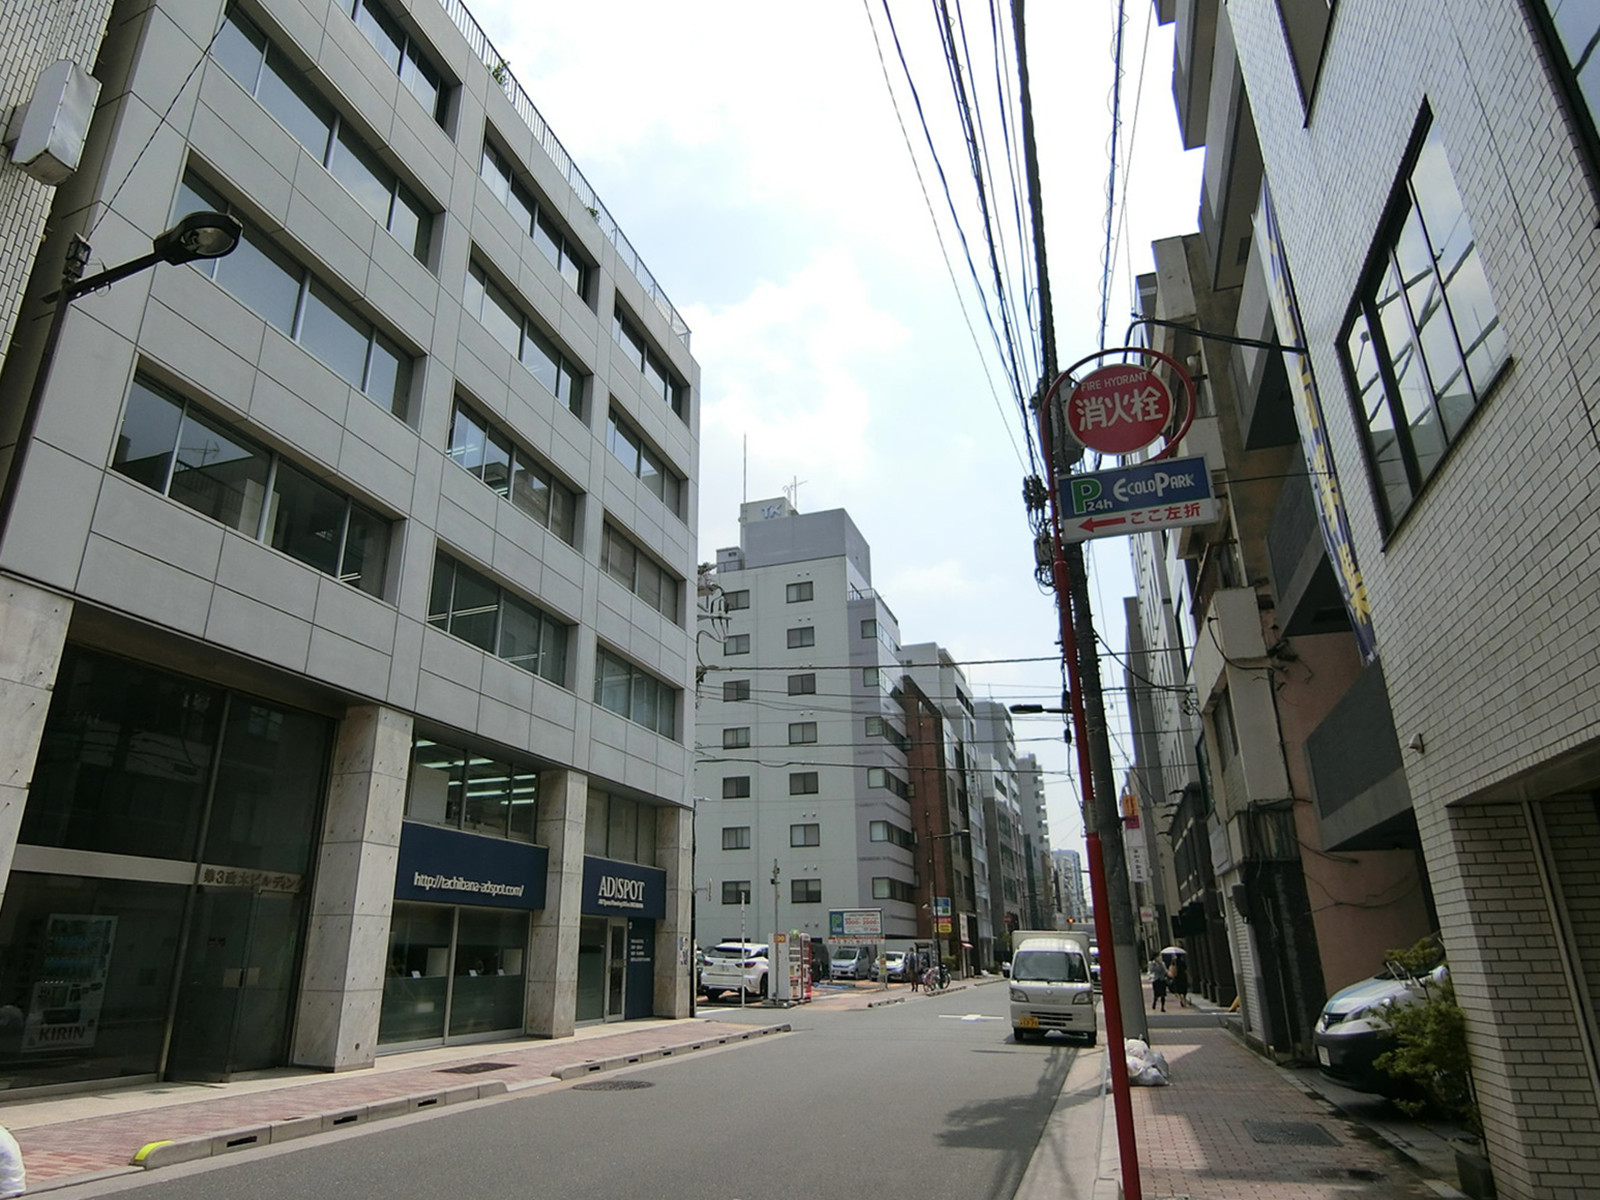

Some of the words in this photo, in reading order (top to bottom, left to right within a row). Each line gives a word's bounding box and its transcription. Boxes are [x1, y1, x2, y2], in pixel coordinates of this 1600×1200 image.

[1081, 378, 1101, 392] FIRE
[1104, 372, 1148, 388] HYDRANT
[1075, 386, 1163, 432] 消火栓
[1071, 478, 1101, 514] P
[1087, 499, 1113, 512] 24h
[1131, 502, 1200, 525] ここ左折
[39, 1026, 85, 1041] KIRIN
